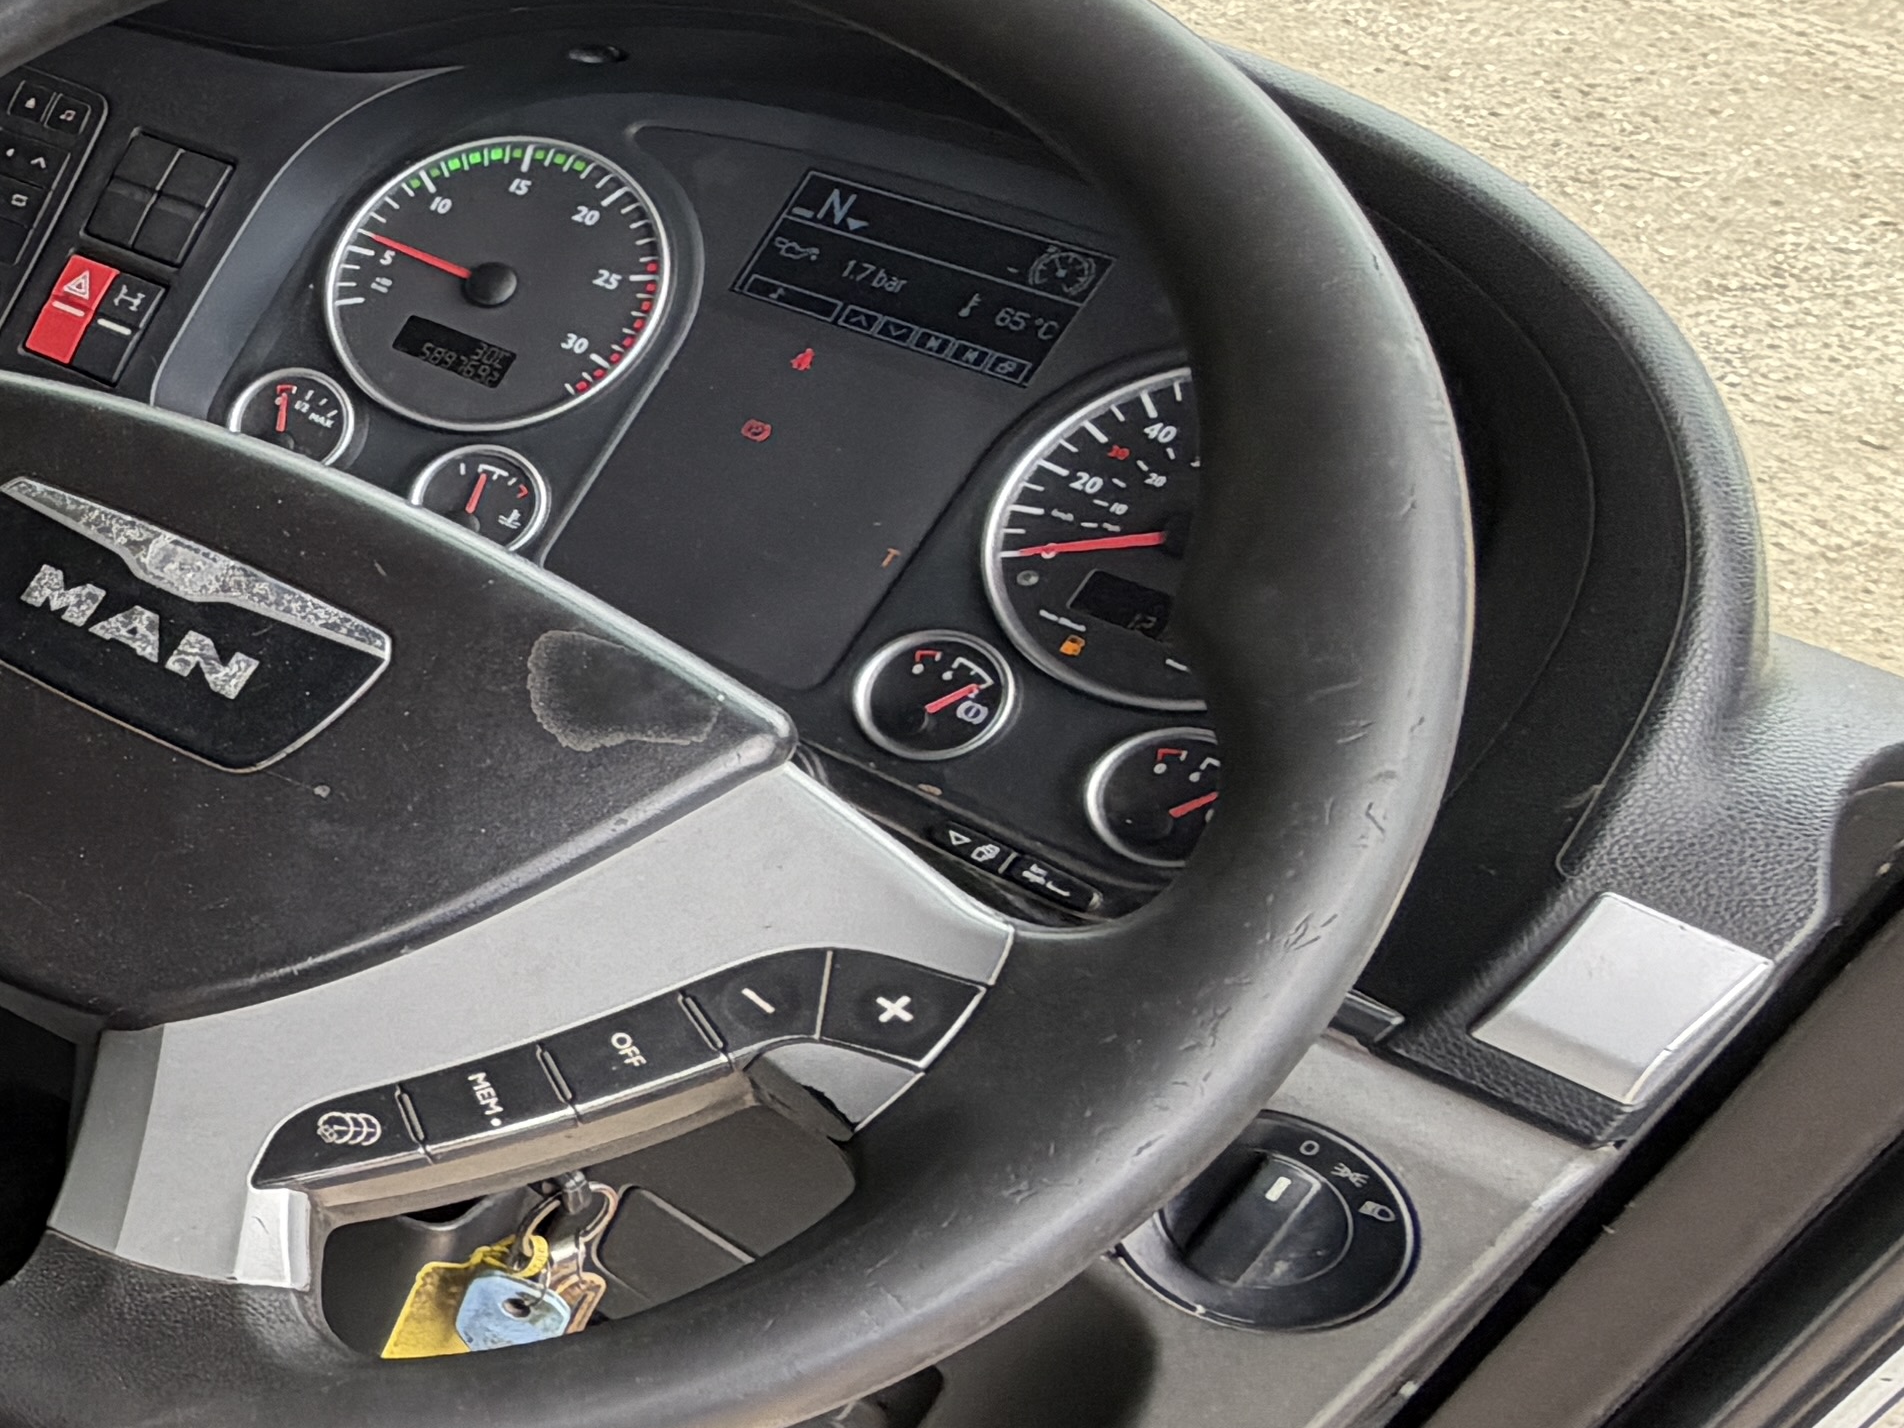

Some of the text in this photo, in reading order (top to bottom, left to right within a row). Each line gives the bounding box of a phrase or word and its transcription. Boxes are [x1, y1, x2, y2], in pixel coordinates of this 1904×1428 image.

[507, 178, 532, 197] 15
[429, 196, 452, 215] 10
[570, 206, 601, 227] 20
[816, 187, 858, 225] N
[379, 249, 396, 266] 5
[592, 269, 622, 290] 25
[994, 307, 1033, 332] 65
[560, 333, 589, 354] 30
[1144, 422, 1178, 444] 40
[1068, 471, 1104, 495] 20
[20, 563, 259, 700] MAN
[611, 1032, 647, 1067] OFF
[467, 1072, 503, 1115] MEM
